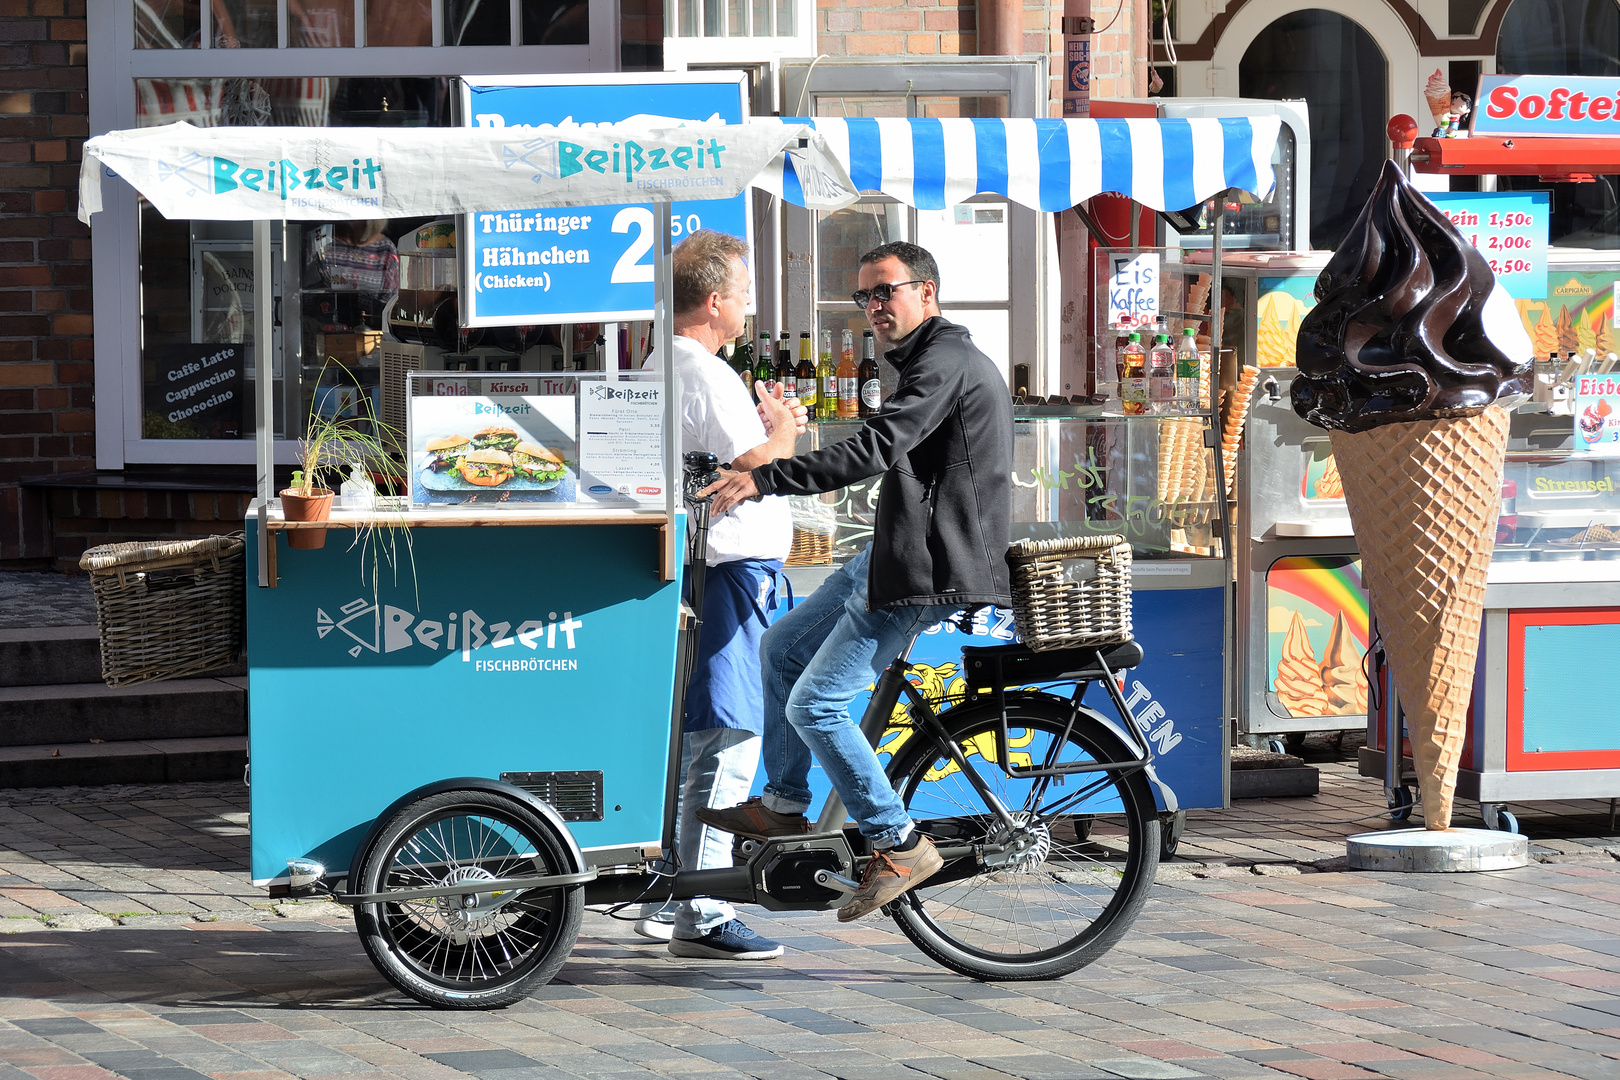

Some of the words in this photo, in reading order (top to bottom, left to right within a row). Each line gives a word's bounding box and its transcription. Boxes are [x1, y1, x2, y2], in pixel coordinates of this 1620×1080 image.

[1486, 87, 1620, 120] Softei
[558, 138, 726, 183] Beißzeit
[213, 156, 381, 200] Beißzeit
[637, 176, 724, 190] FISCHBRÖTCHEN
[292, 196, 378, 207] FISCHBRÖTCHEN
[479, 213, 591, 236] Thüringer
[1489, 213, 1532, 229] 1,50€
[1489, 236, 1532, 252] 2,00€
[482, 245, 590, 267] Hähnchen
[1114, 258, 1153, 285] Eis
[1489, 259, 1532, 275] 2,50€
[475, 272, 551, 293] (Chicken)
[1110, 288, 1156, 318] Kaffee
[167, 362, 201, 382] Caffe
[201, 348, 235, 368] Latte
[165, 368, 236, 403] Cappuccino
[436, 382, 467, 396] Cola
[490, 382, 529, 393] Kirsch
[607, 387, 659, 402] Beißzeit
[168, 390, 234, 423] Chococino
[475, 402, 531, 417] Beißzeit
[1535, 476, 1614, 492] Streusel
[384, 605, 583, 662] Beißzeit
[475, 659, 578, 671] FISCHBRÖTCHEN
